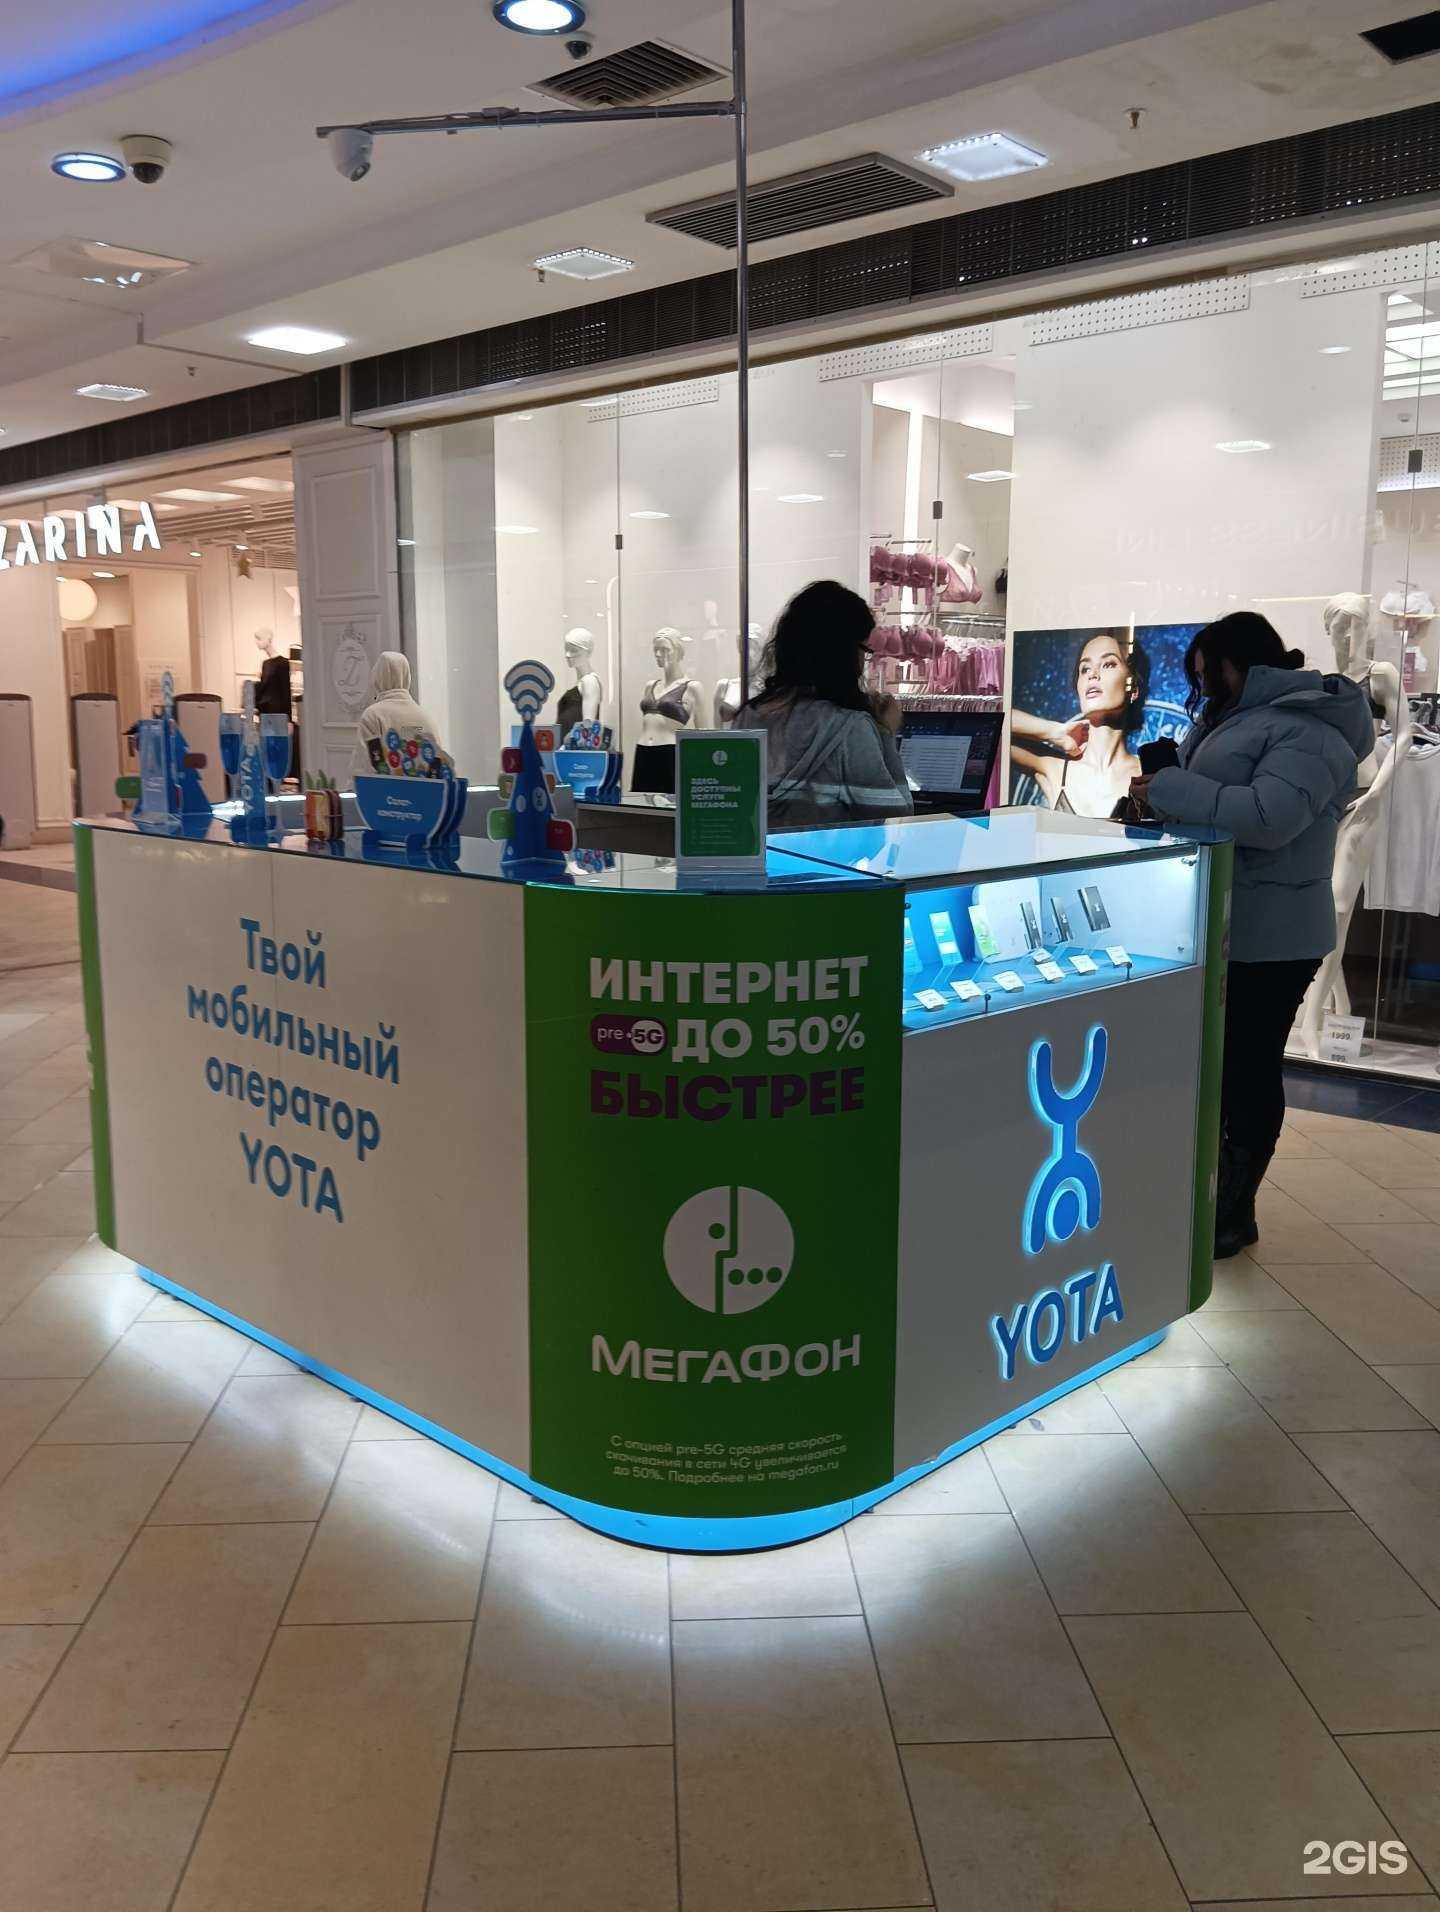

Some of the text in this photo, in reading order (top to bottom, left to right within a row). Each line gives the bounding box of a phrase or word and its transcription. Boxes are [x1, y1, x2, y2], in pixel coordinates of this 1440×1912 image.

[240, 917, 327, 989] Твой
[589, 955, 869, 1004] ИНТЕРНЕТ
[187, 984, 400, 1085] мобильный
[672, 1017, 752, 1064] ДО
[766, 1012, 866, 1057] 50%
[205, 1056, 381, 1162] оператор
[590, 1066, 865, 1122] БЫСТРЕЕ
[240, 1131, 344, 1224] YOTA
[991, 1263, 1124, 1380] YOTA
[605, 1450, 682, 1468] скачивания
[695, 1459, 727, 1469] сети
[729, 1456, 751, 1469] 4G
[754, 1444, 848, 1470] увеличивается
[610, 1432, 843, 1457] С опцией pre-5G средняя скорость
[613, 1466, 630, 1478] до
[668, 1470, 744, 1485] Подробнее
[748, 1471, 764, 1482] на
[768, 1461, 839, 1481] megafon.ru
